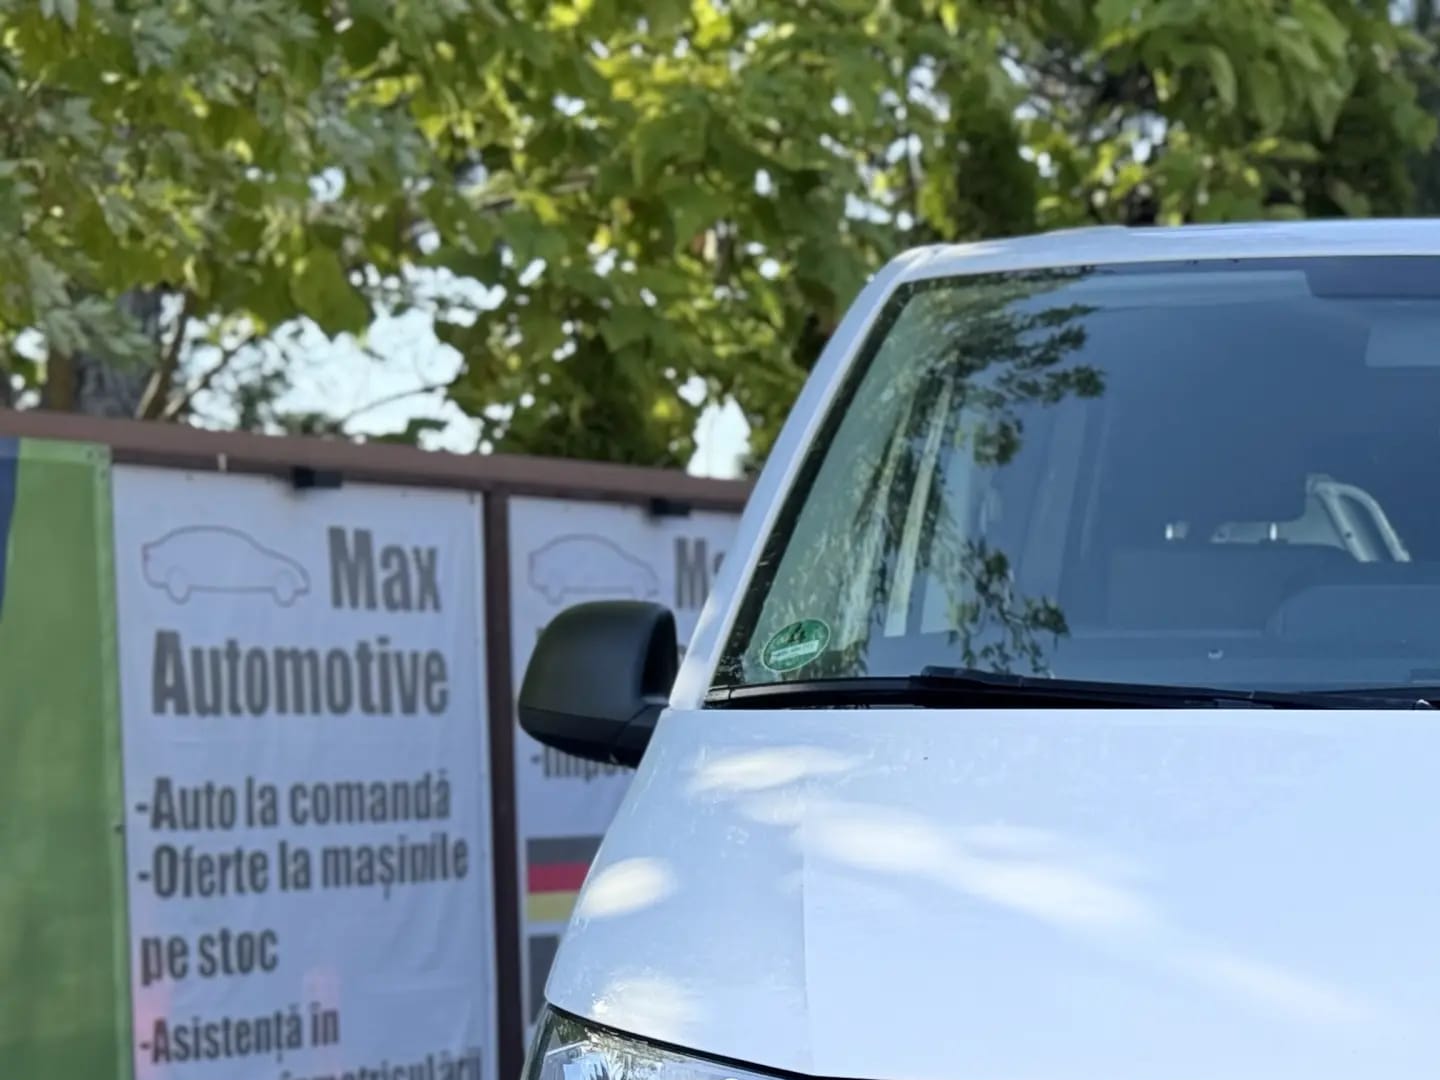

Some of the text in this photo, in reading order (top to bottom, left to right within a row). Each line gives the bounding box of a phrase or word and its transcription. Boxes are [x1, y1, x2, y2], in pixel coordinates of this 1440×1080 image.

[327, 525, 441, 613] Max
[152, 629, 449, 718] Automotive
[135, 768, 452, 831] -Auto la comandă
[136, 831, 471, 901] -Oferte la mașinile
[140, 927, 279, 987] pe stoc
[139, 1003, 304, 1065] -Asistență
